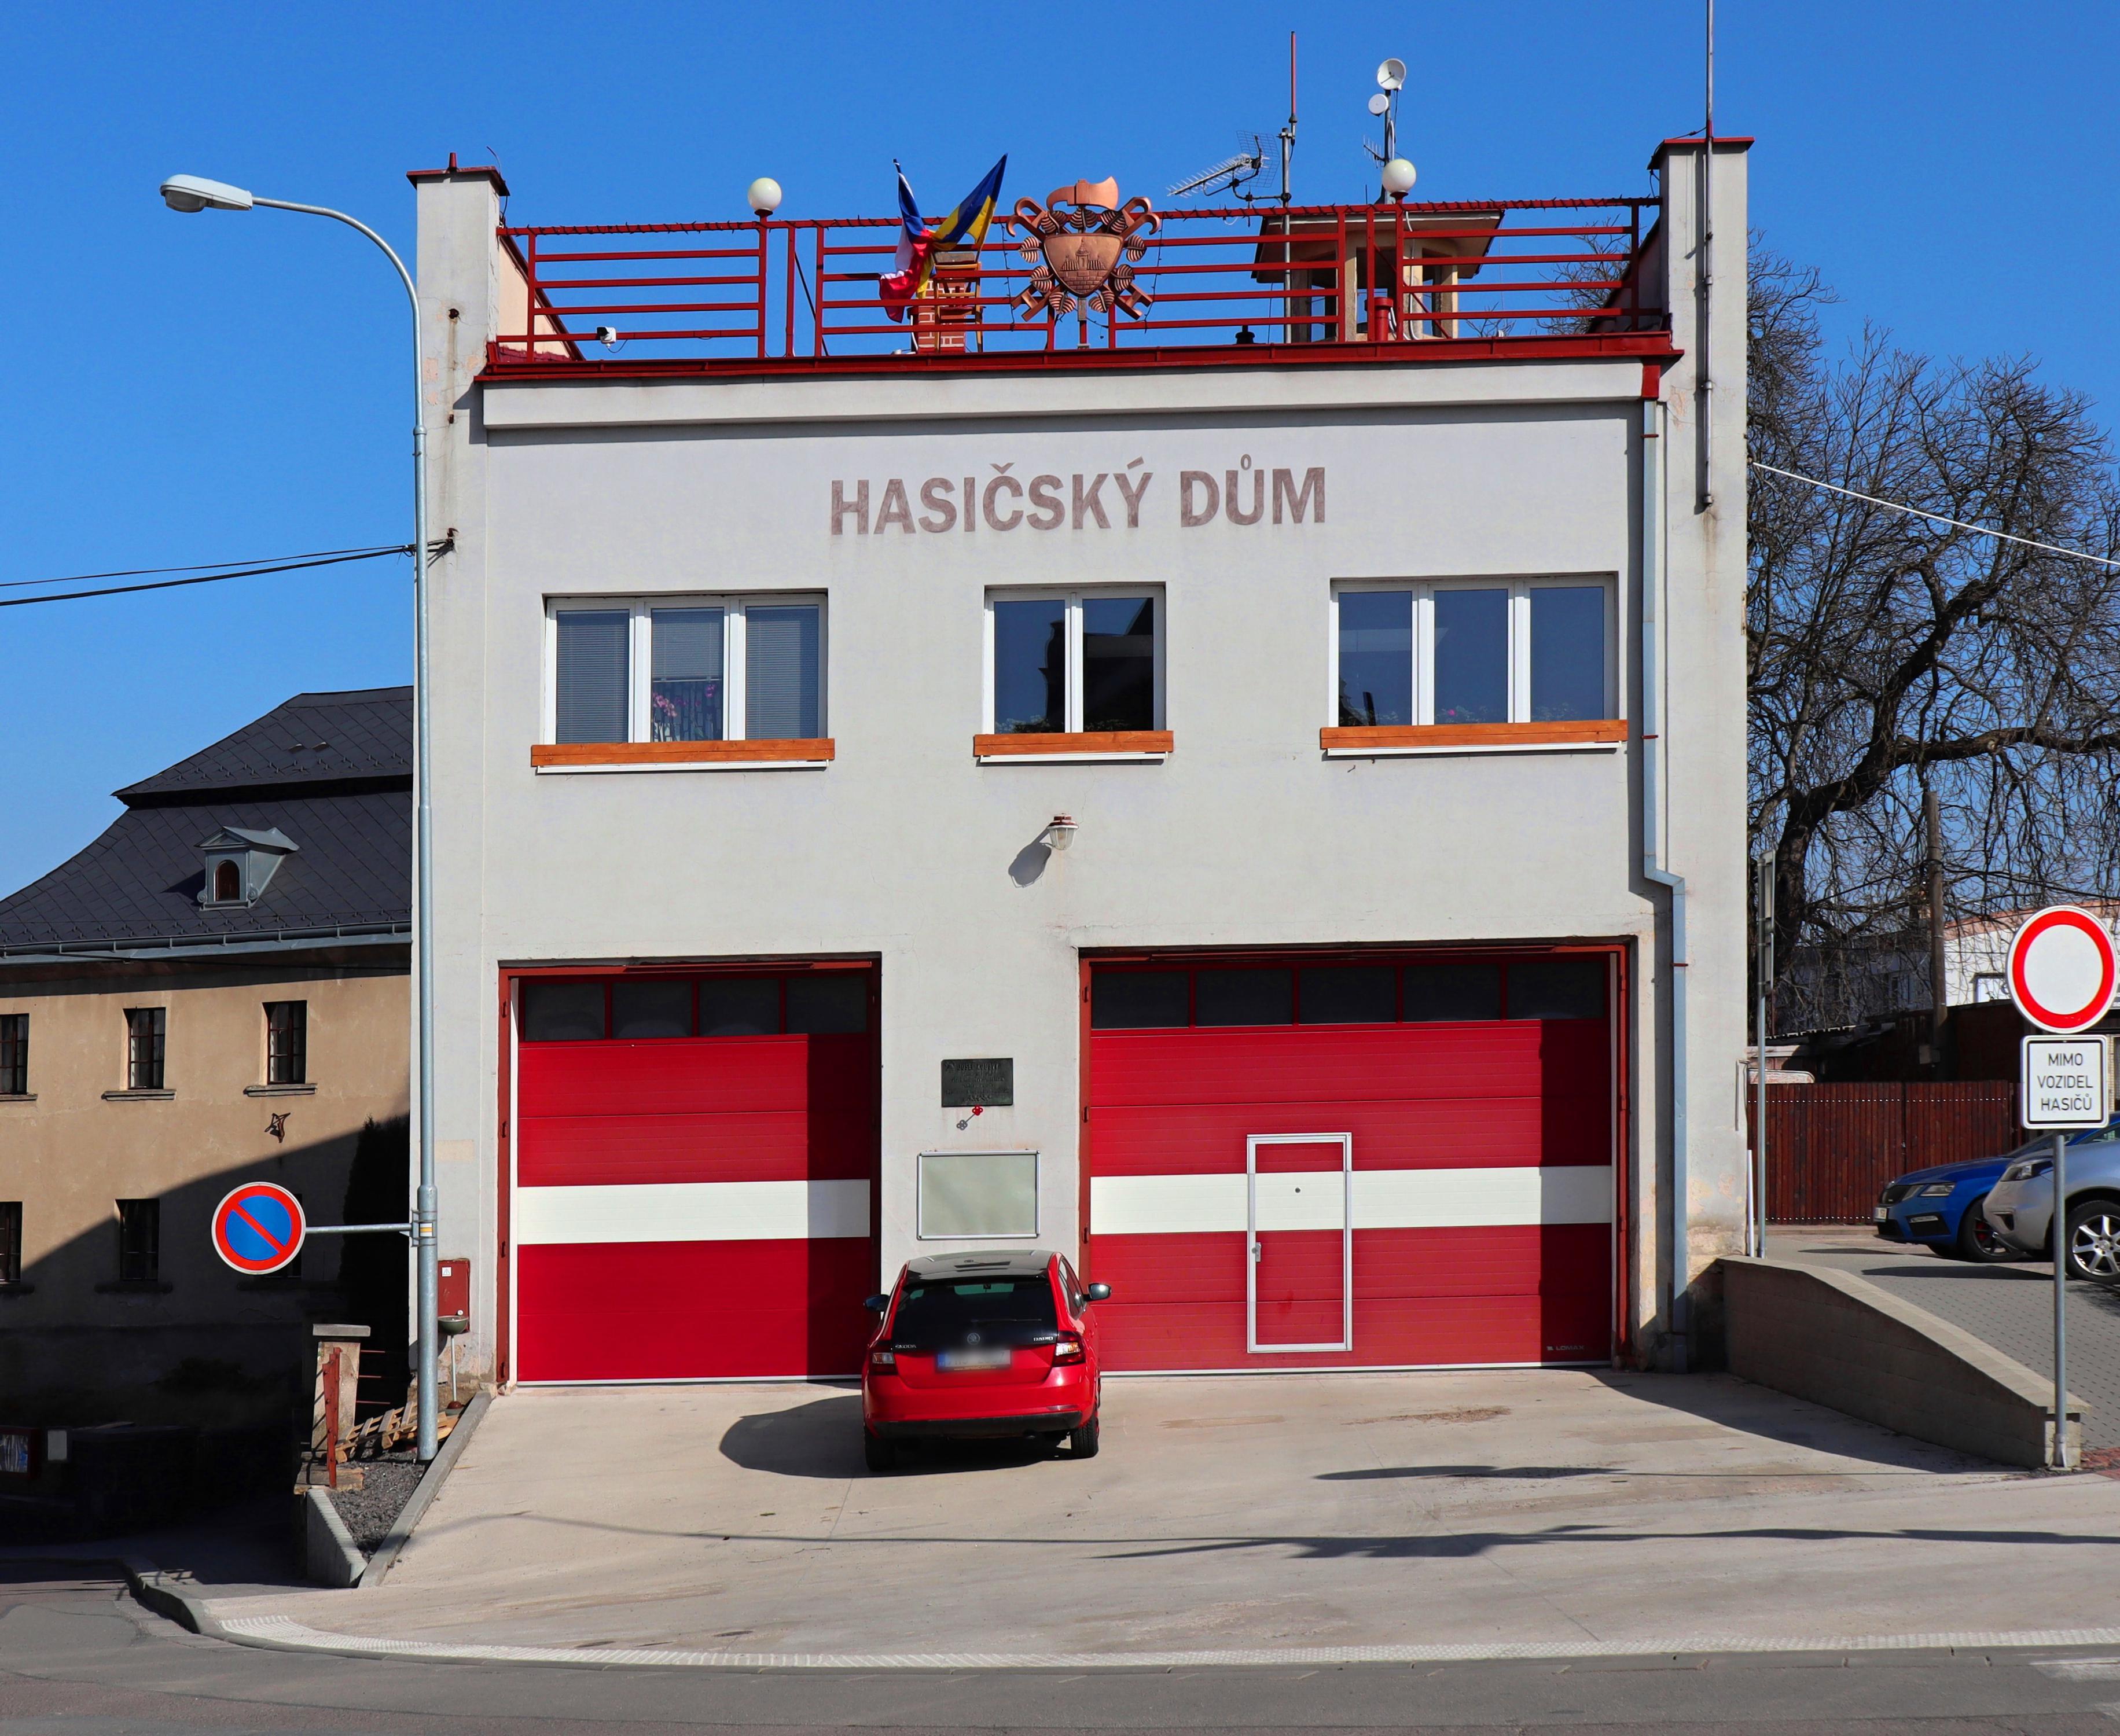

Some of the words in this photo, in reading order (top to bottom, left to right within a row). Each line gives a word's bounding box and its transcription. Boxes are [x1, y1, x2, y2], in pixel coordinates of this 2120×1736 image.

[831, 456, 1153, 536] HASIČSKÝ
[1180, 454, 1326, 528] DŮM
[2048, 1053, 2083, 1066] MIMO
[2037, 1075, 2093, 1088] VOZIDEL
[2041, 1093, 2092, 1111] HASIČŮ
